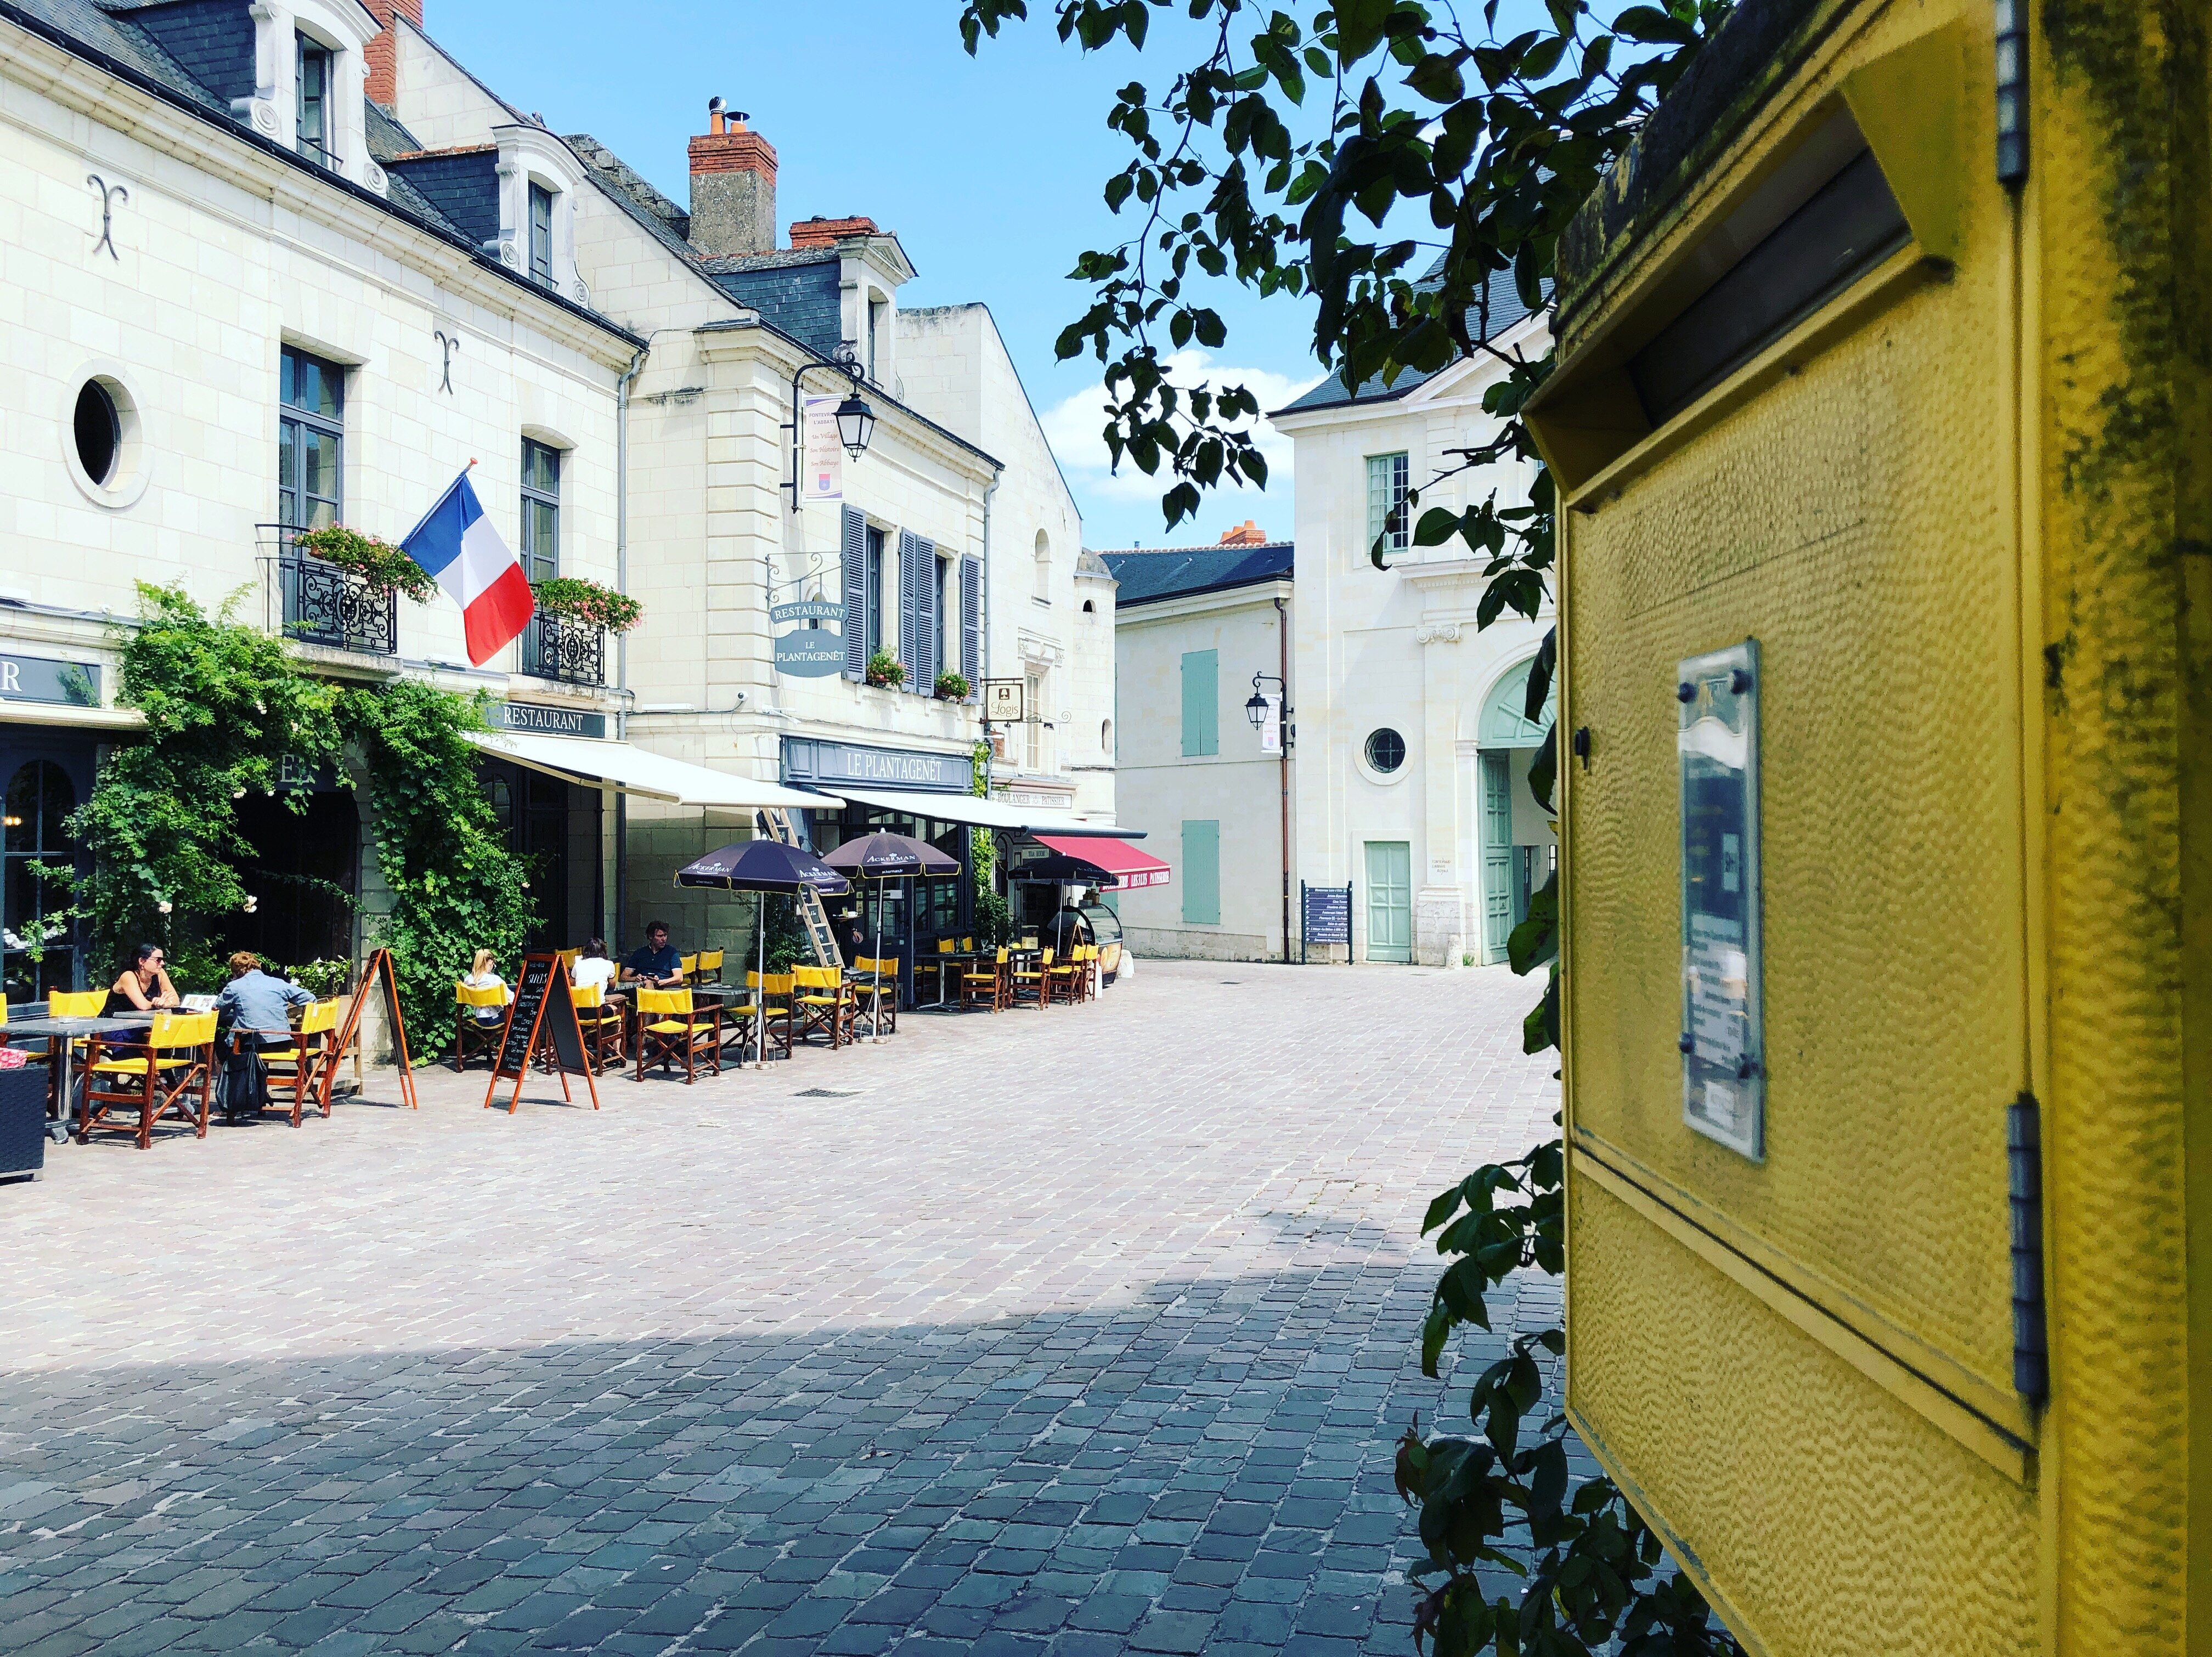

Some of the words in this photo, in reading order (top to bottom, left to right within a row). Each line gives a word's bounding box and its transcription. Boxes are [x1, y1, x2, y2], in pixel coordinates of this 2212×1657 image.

[820, 432, 838, 441] Village
[819, 459, 839, 468] Abbaye
[774, 606, 845, 620] RESTAURANT
[805, 641, 815, 649] LE
[776, 650, 845, 662] PLANTAGENÊT
[990, 700, 1019, 717] Logis
[503, 706, 583, 731] RESTAURANT
[847, 753, 862, 777] LE
[865, 754, 942, 782] PLANTAGENÊT
[997, 793, 1030, 804] BOULANGER
[1041, 795, 1065, 806] PATISSIER
[687, 862, 732, 873] ACKERMAN
[799, 869, 838, 878] ACKERMAN
